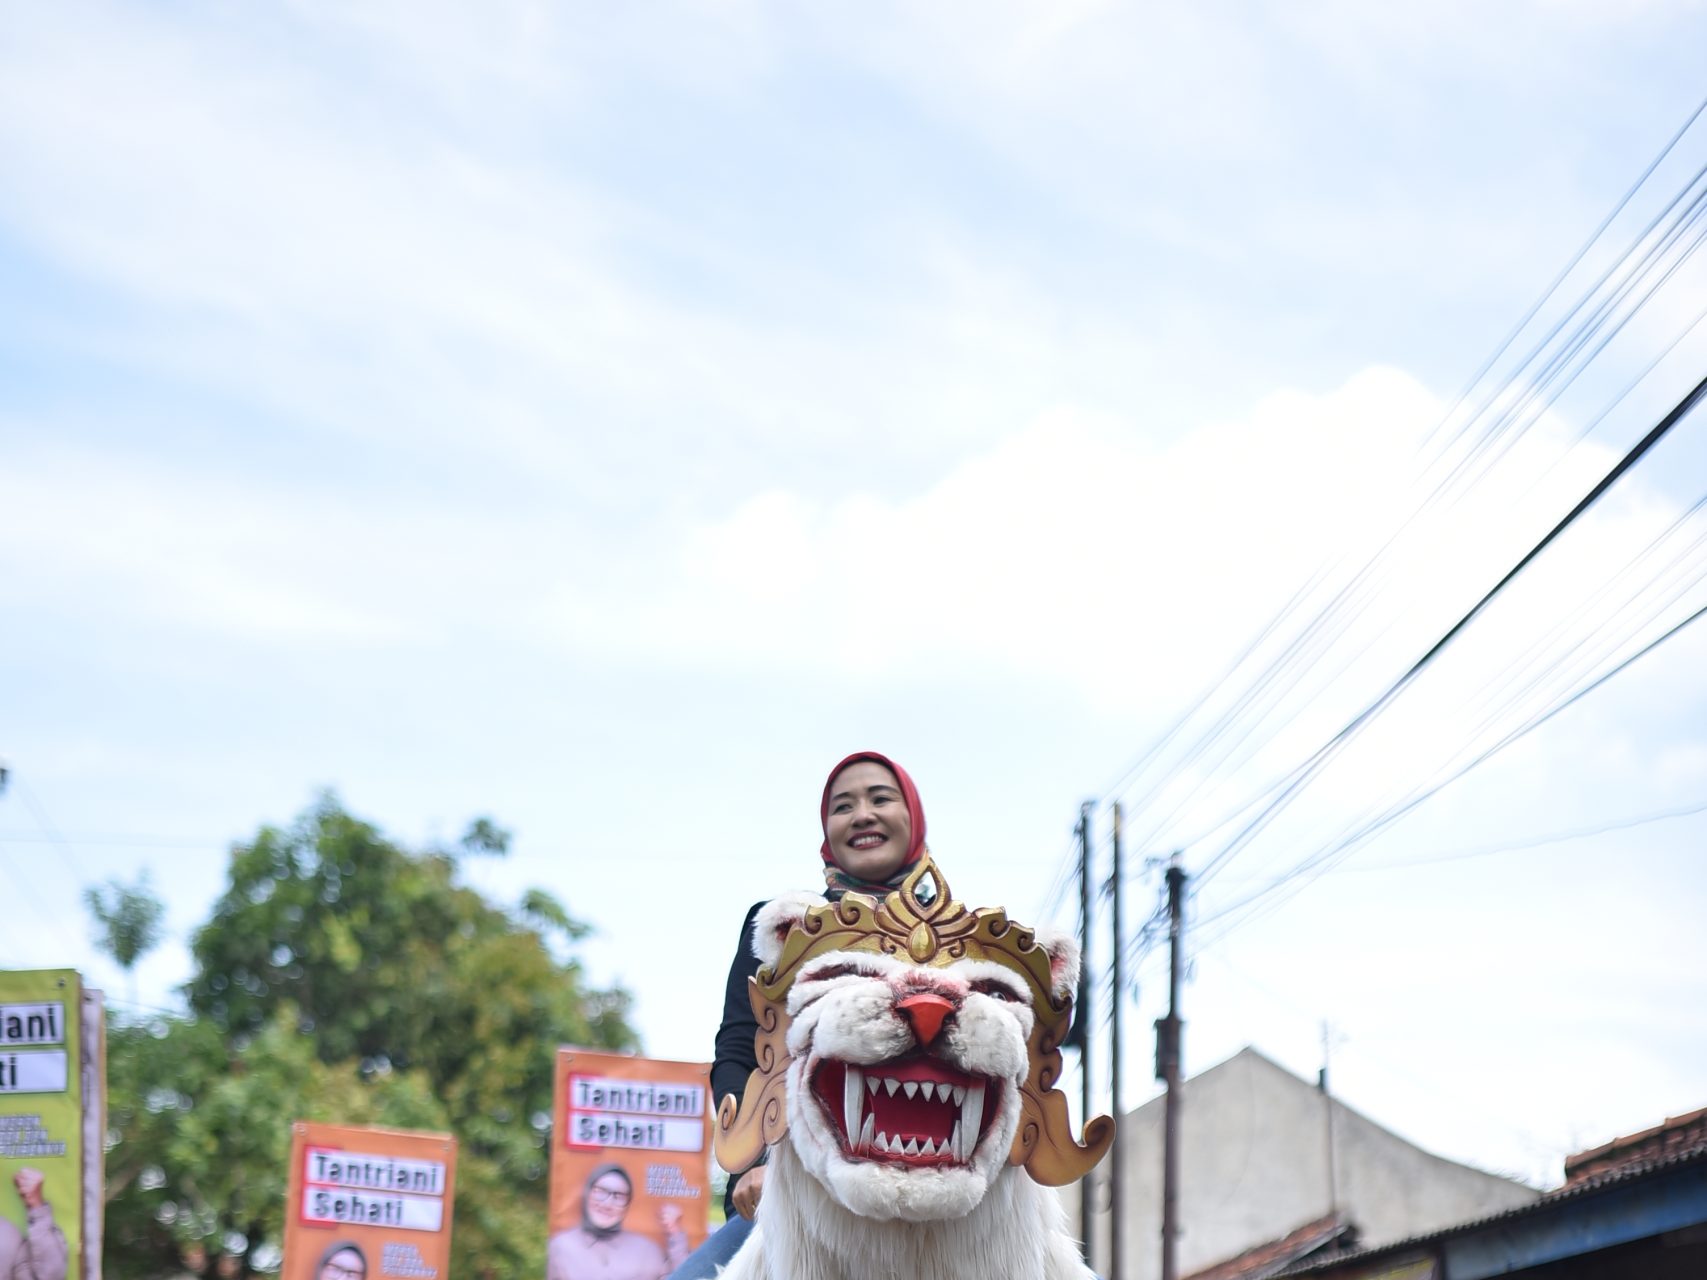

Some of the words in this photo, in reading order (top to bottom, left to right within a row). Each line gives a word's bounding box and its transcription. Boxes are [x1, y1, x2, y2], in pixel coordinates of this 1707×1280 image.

[579, 1081, 697, 1112] Tantriani
[579, 1117, 665, 1146] Sehati
[315, 1155, 437, 1189] Tantriani
[314, 1192, 403, 1223] Sehati
